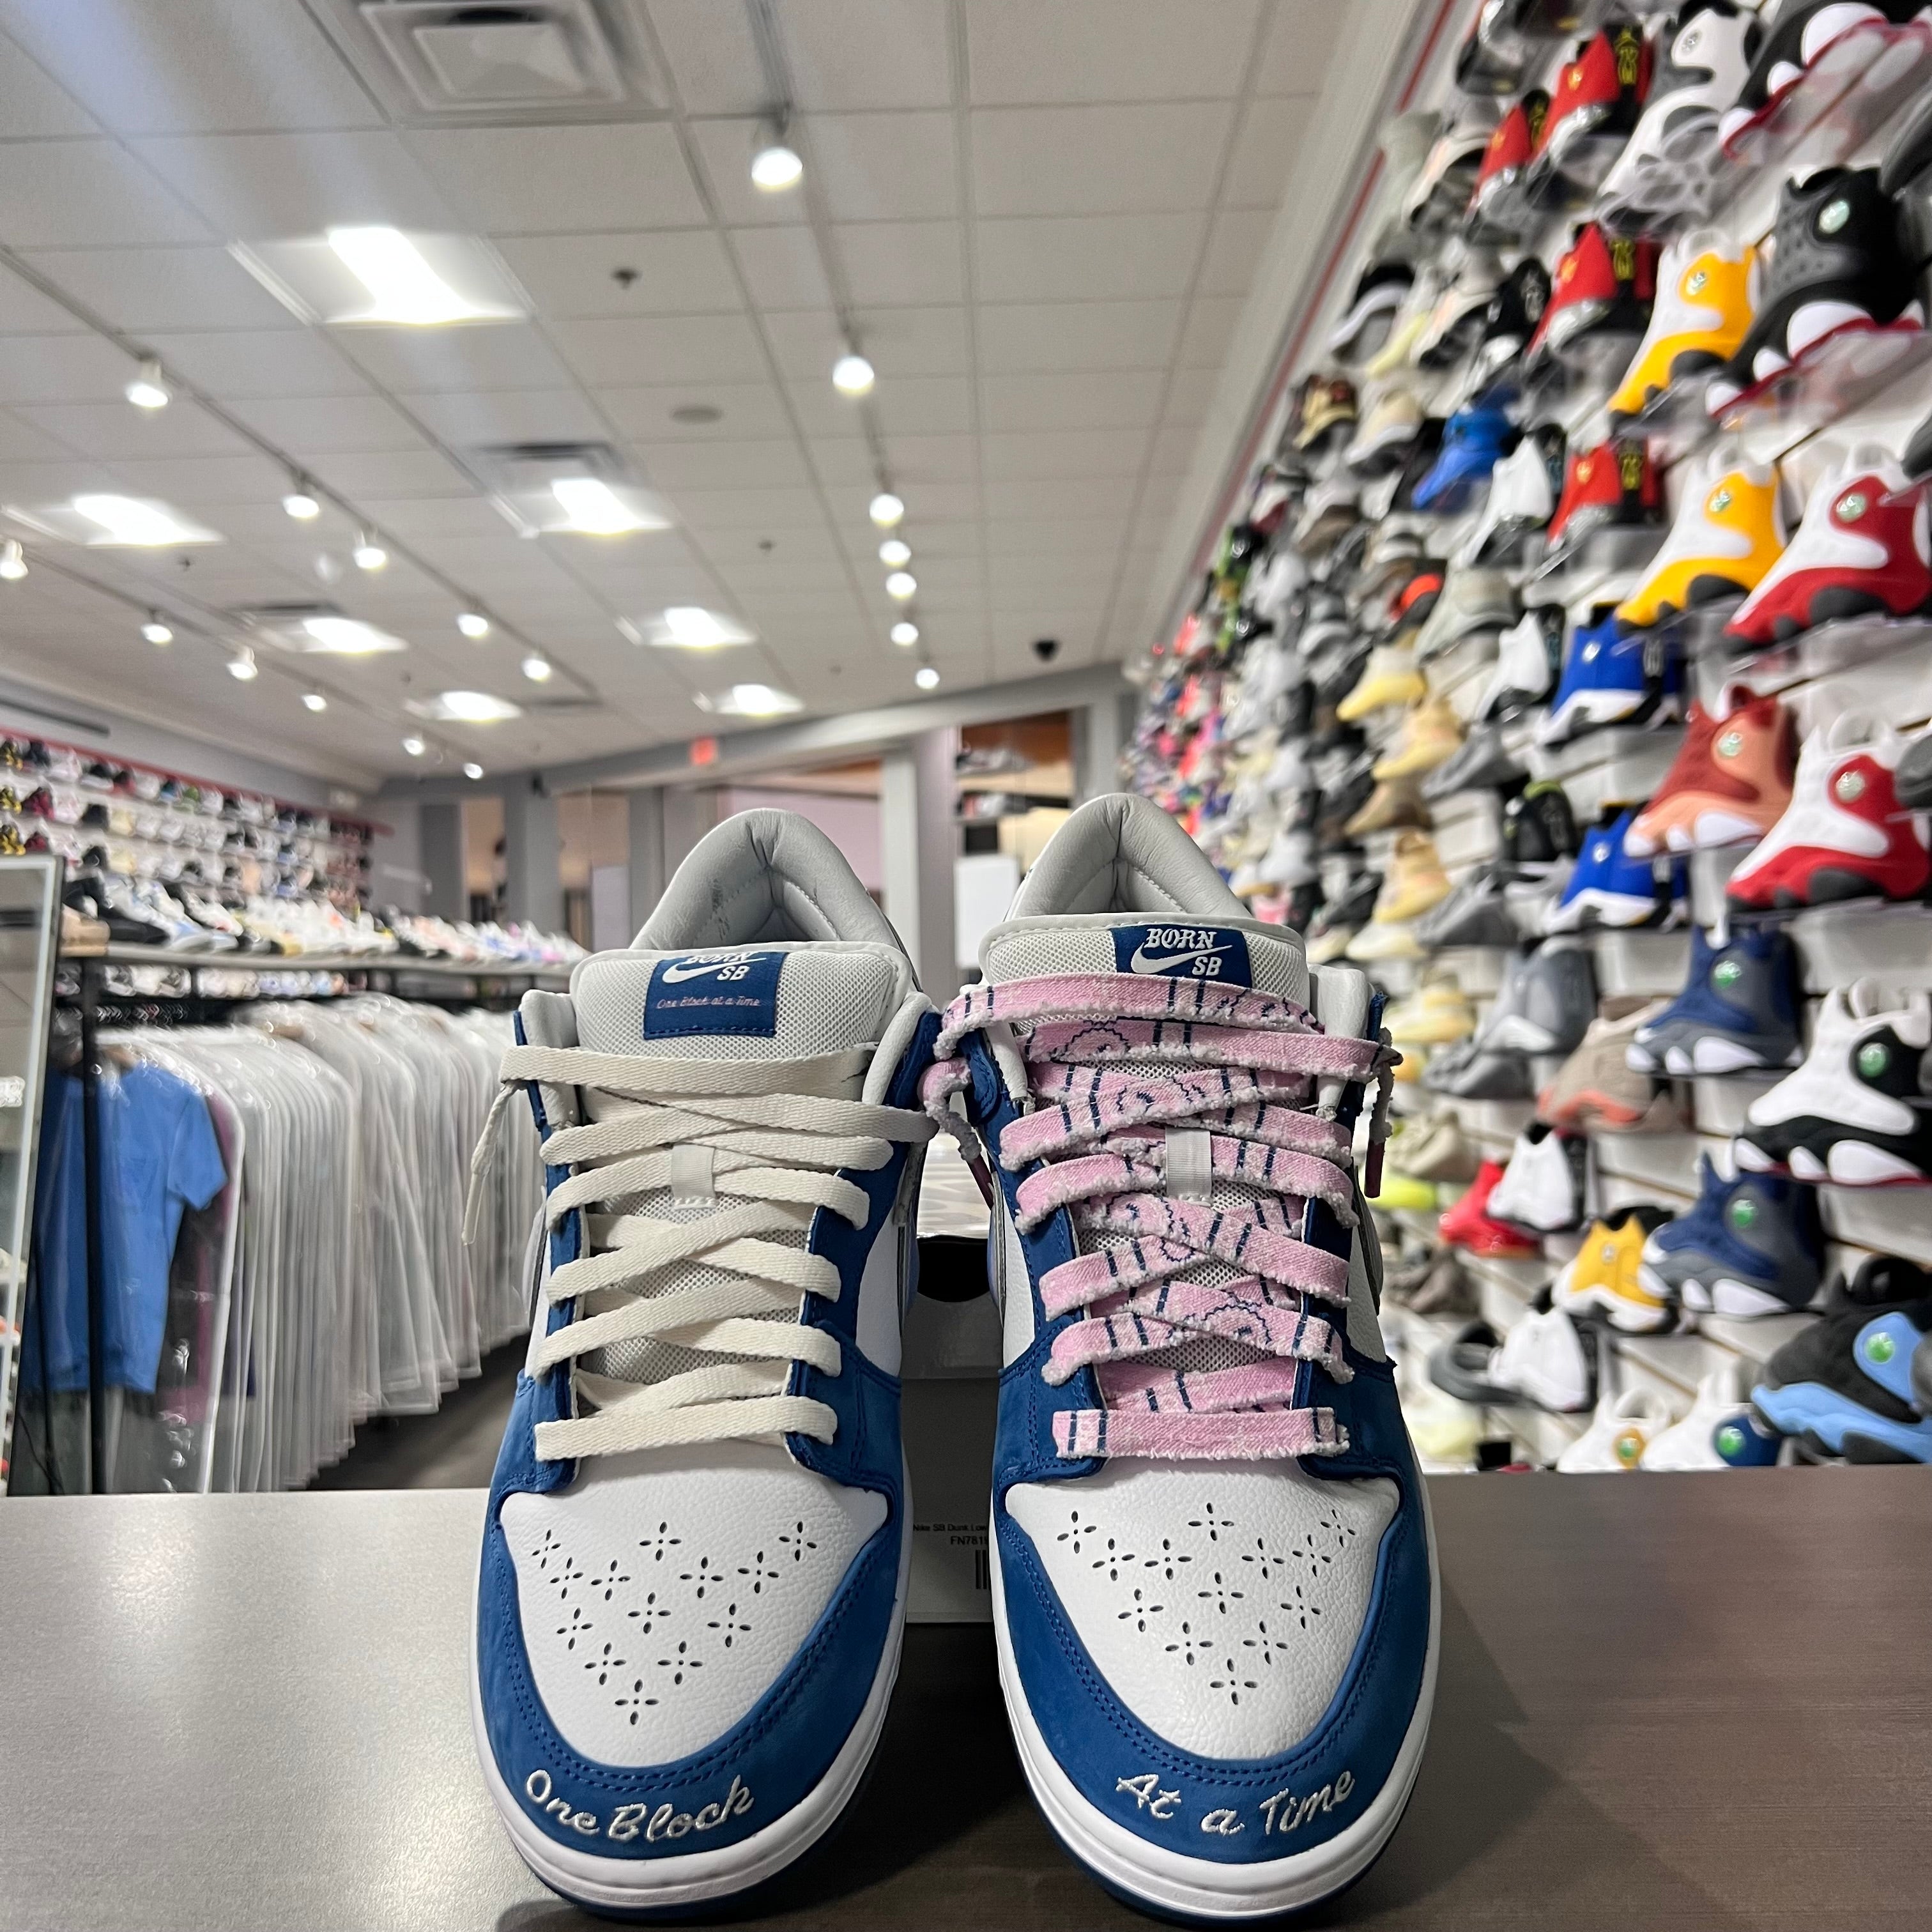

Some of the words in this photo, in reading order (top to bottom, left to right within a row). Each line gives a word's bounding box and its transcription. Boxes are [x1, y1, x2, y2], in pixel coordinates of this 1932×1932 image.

[1144, 928, 1217, 949] BORN
[717, 965, 750, 981] SB
[1192, 956, 1222, 976] SB
[656, 999, 677, 1009] One
[680, 996, 710, 1007] Block
[710, 996, 724, 1006] at
[724, 997, 735, 1006] a
[735, 995, 762, 1006] Time
[913, 1523, 930, 1531] Nike
[933, 1523, 945, 1531] SB
[947, 1523, 968, 1531] Dunk
[526, 1769, 600, 1835] One
[608, 1774, 755, 1843] Block
[1116, 1774, 1182, 1820] At
[1200, 1807, 1245, 1836] a
[1259, 1770, 1356, 1835] Time
